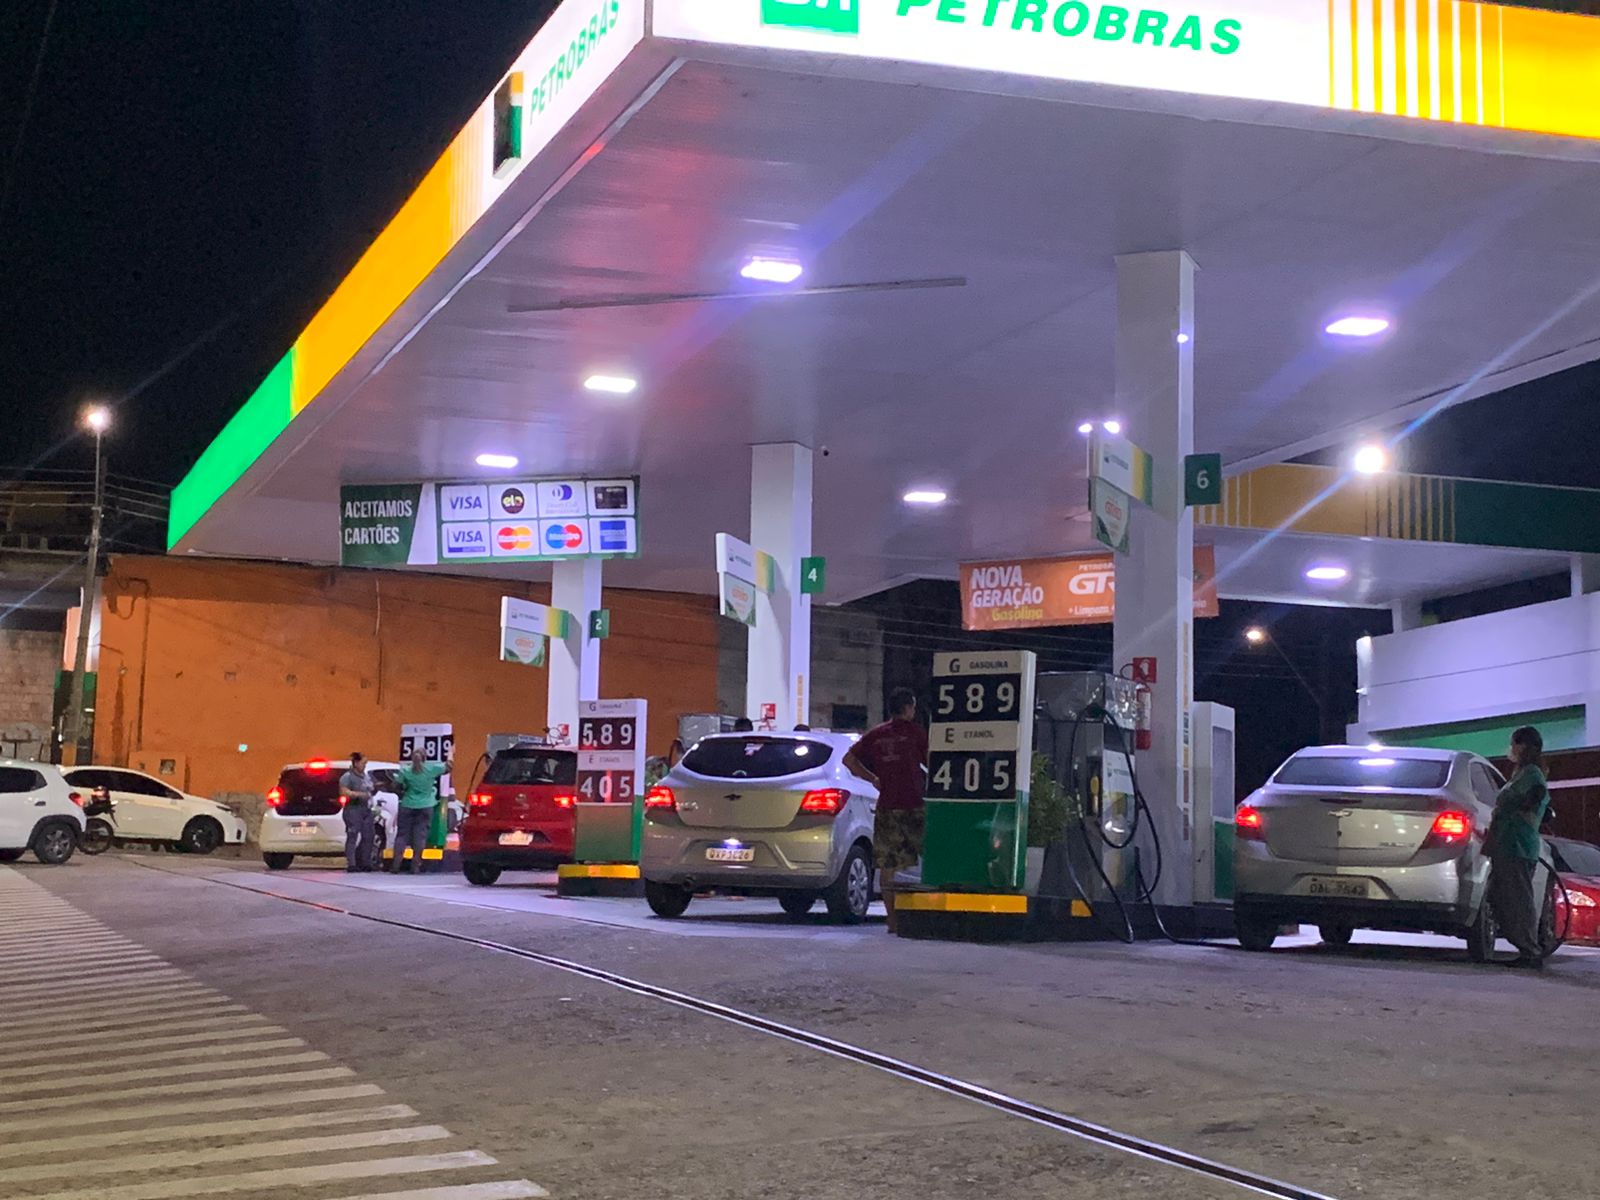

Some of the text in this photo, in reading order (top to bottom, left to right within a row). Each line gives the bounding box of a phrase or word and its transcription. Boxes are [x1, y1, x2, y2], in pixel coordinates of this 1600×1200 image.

[530, 0, 618, 125] PETROBRAS
[1197, 469, 1209, 489] 6
[344, 500, 412, 518] ACEITAMOS
[450, 496, 482, 509] VISA
[344, 523, 399, 545] CARTÕES
[452, 530, 483, 542] VISA
[807, 566, 817, 582] 4
[971, 565, 1022, 589] NOVA
[972, 583, 1044, 609] GERAÇÃO
[992, 606, 1043, 621] Gasolina
[595, 618, 603, 630] 2
[949, 658, 1008, 673] G GASOLINA
[589, 702, 597, 712] G
[945, 727, 994, 743] E ETANOL
